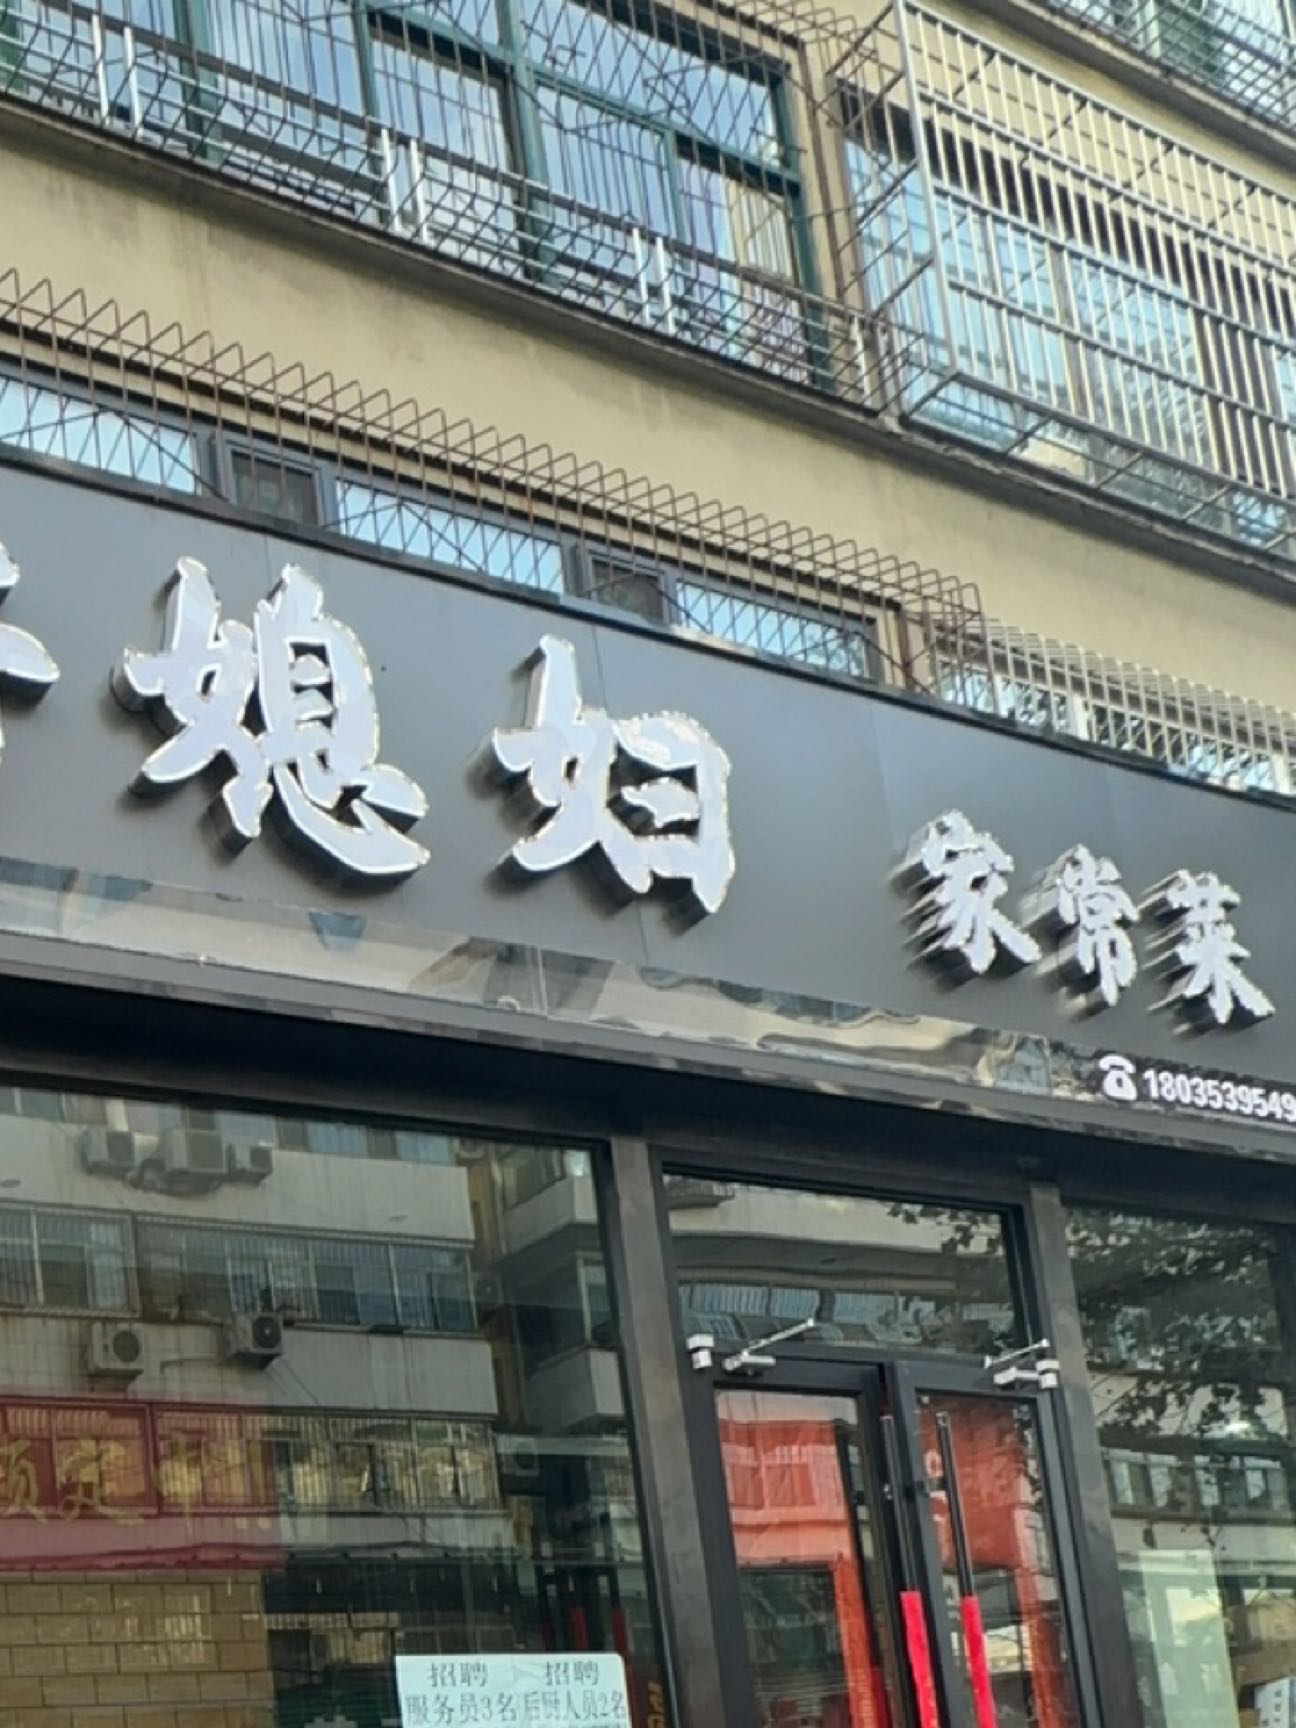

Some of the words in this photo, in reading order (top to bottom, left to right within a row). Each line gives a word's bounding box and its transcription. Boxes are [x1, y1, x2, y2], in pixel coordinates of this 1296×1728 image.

[912, 808, 1276, 1027] 家常菜
[428, 1661, 488, 1688] 招聘
[544, 1660, 601, 1687] 招聘
[405, 1690, 518, 1725] 服务员3名
